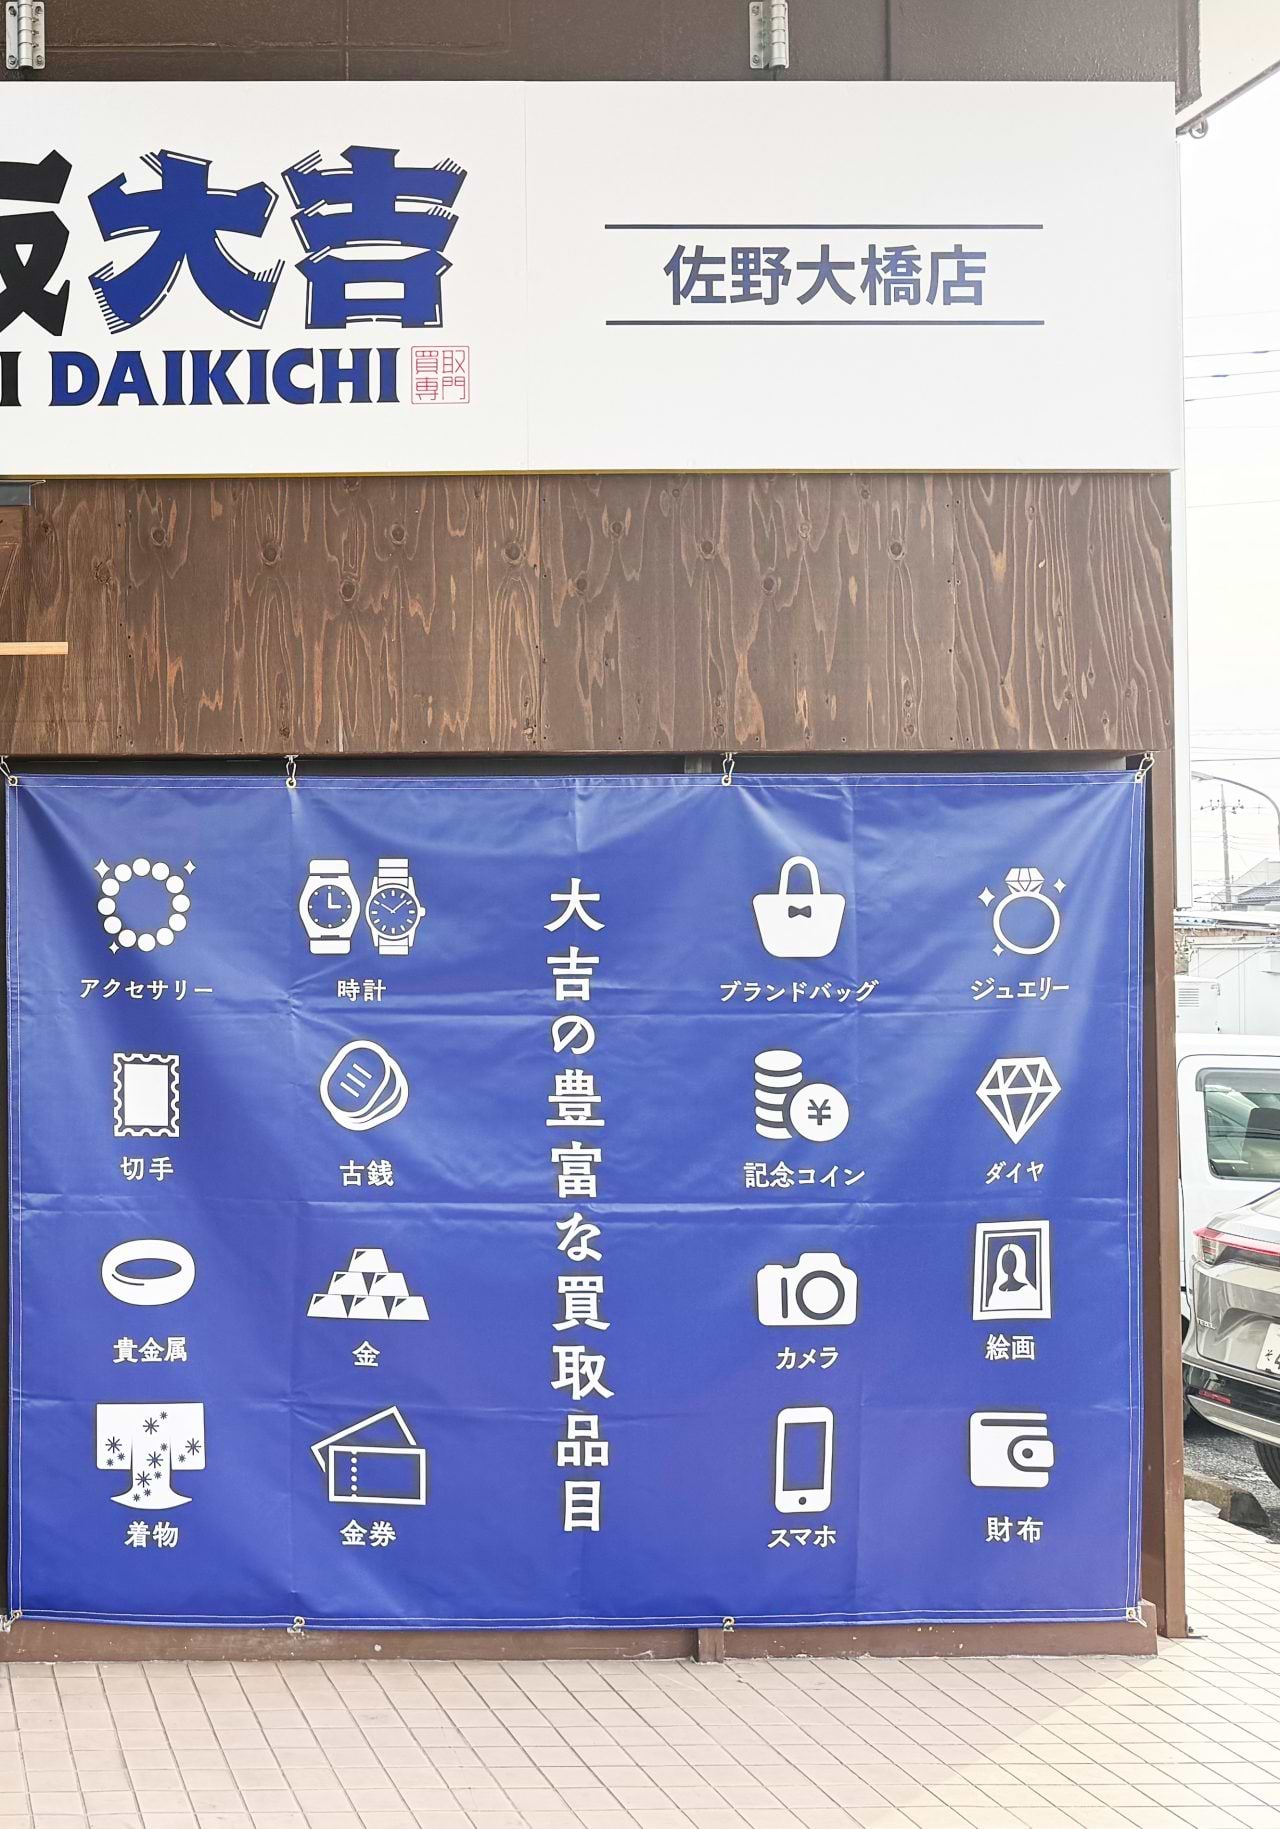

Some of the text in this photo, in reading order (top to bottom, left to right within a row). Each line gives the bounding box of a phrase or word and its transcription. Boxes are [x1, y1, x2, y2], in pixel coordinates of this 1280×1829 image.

[663, 243, 987, 306] 佐野大橋店
[414, 349, 466, 374] 買取
[48, 347, 401, 407] DAIKICHI
[414, 376, 466, 401] 専門
[80, 978, 214, 1001] アクセサリー
[337, 978, 387, 1002] 時計
[720, 979, 880, 1003] ブランドバッグ
[970, 976, 1070, 1001] ジュエリー
[807, 1098, 832, 1126] ¥
[120, 1156, 174, 1181] 切手
[339, 1159, 395, 1187] 古銭
[743, 1161, 866, 1188] 記念コイン
[984, 1160, 1045, 1185] ダイヤ
[543, 877, 615, 1532] 大吉の豊富な買取品目
[112, 1336, 188, 1364] 貴金属
[351, 1340, 381, 1367] 金
[775, 1346, 840, 1370] カメラ
[985, 1334, 1036, 1361] 絵画
[124, 1520, 180, 1548] 着物
[339, 1519, 397, 1548] 金券
[767, 1525, 837, 1549] スマホ
[985, 1516, 1044, 1543] 財布
